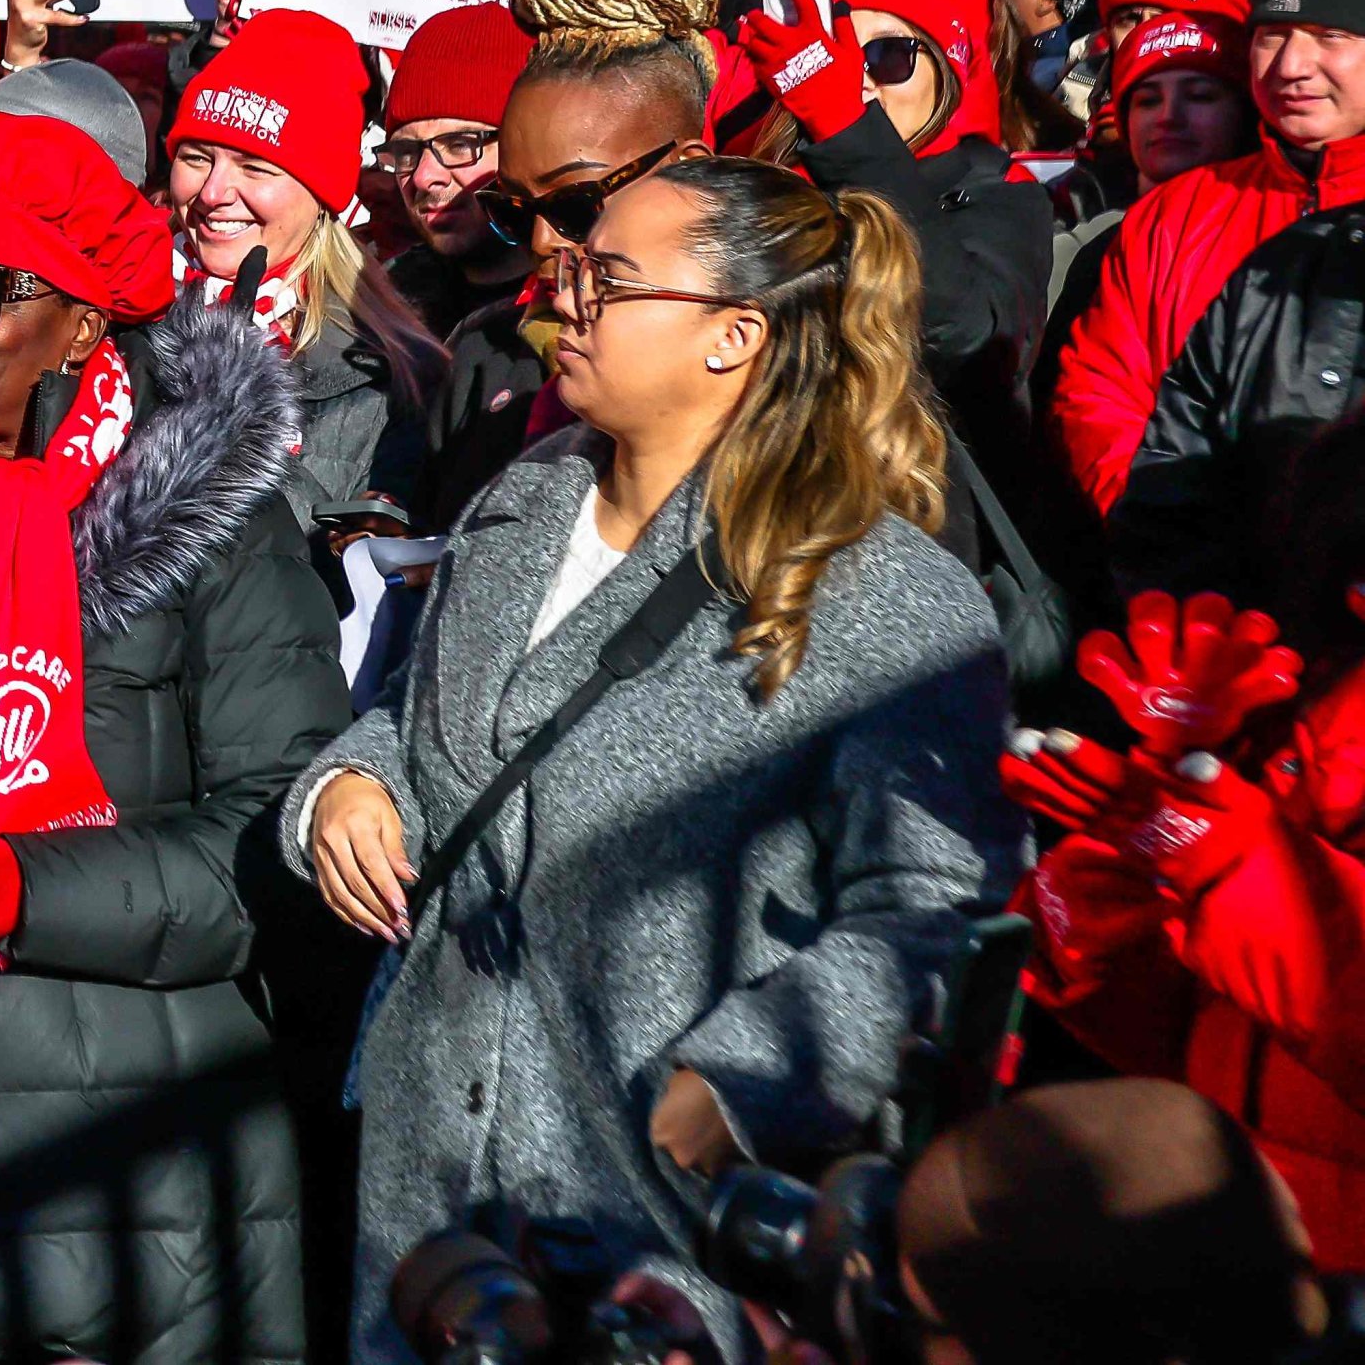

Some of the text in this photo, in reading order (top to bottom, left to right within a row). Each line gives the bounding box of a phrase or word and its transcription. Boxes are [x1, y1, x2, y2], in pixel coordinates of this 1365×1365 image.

[195, 89, 287, 134] NURSES
[228, 85, 250, 98] New
[249, 91, 268, 106] York
[11, 645, 73, 694] CARE
